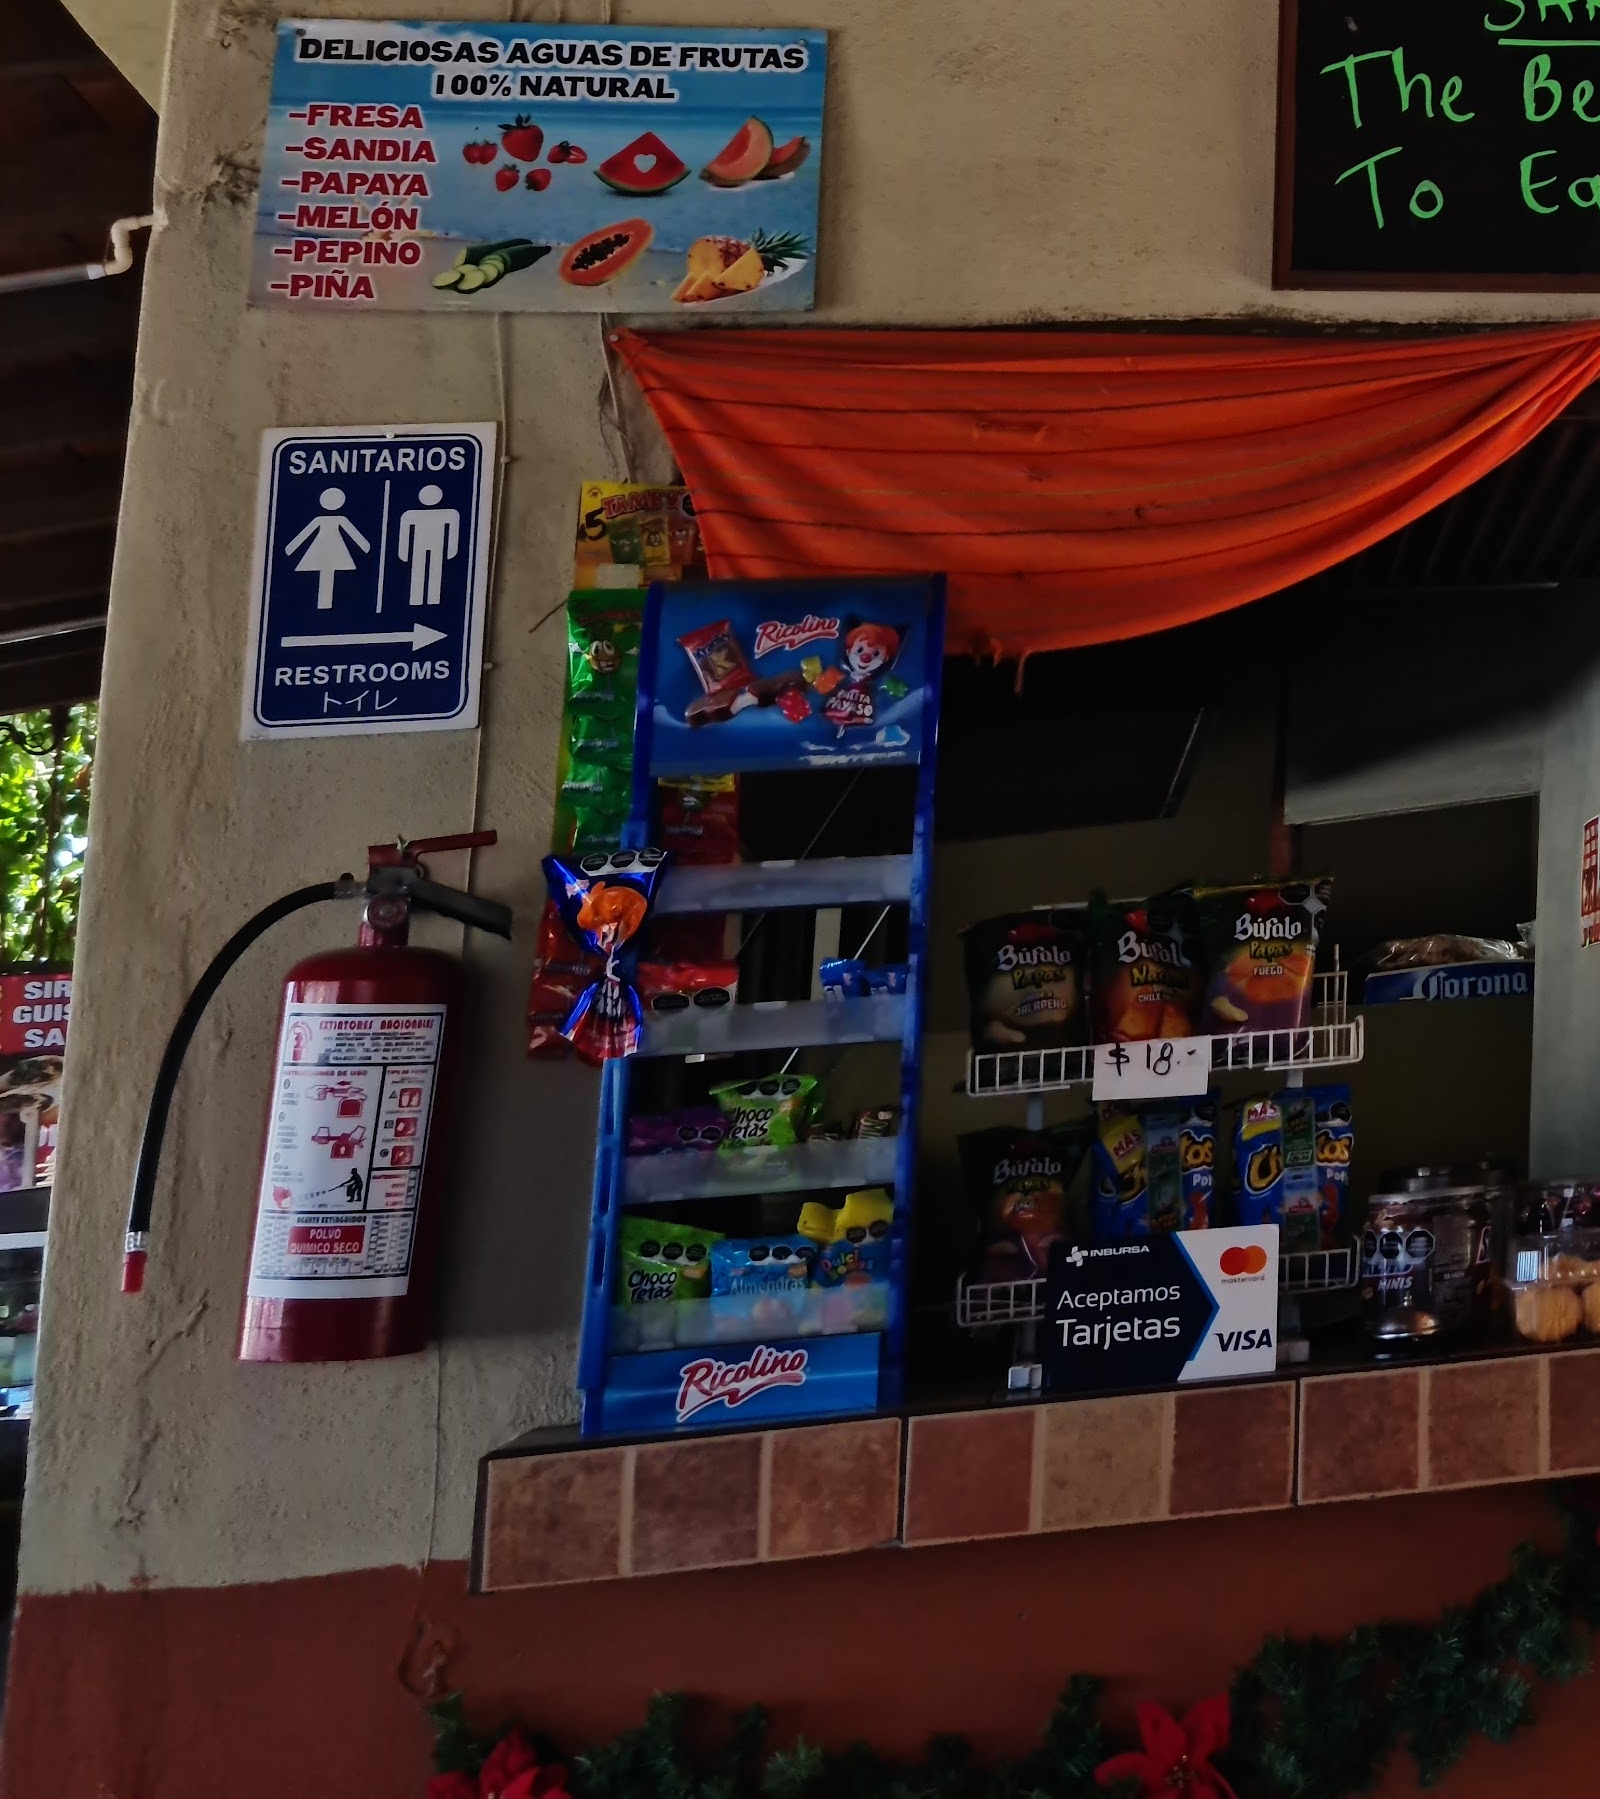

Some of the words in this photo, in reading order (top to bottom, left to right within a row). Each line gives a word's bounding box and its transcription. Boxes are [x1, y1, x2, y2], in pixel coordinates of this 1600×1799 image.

[298, 37, 500, 66] DELICIOSAS
[505, 40, 624, 68] AGUAS
[628, 44, 675, 68] DE
[678, 46, 806, 70] FRUTAS
[434, 73, 512, 99] 100%
[518, 75, 677, 100] NATURAL
[1319, 46, 1476, 129] The
[1335, 146, 1444, 230] To
[288, 447, 466, 475] SANITARIOS
[755, 614, 841, 659] Ricolino
[274, 660, 450, 687] RESTROOMS
[322, 689, 398, 713] トイレ
[825, 694, 874, 718] PAYASO
[1233, 912, 1302, 941] Búfalo
[996, 944, 1072, 971] Búfalo
[1250, 940, 1293, 964] Papas
[1253, 965, 1284, 976] FUEGO
[1400, 969, 1531, 1002] Corona
[309, 1228, 342, 1240] POLVO
[290, 1241, 331, 1254] QUIMICO
[332, 1241, 360, 1253] SECO
[1090, 1244, 1151, 1258] INBURSA
[627, 1269, 677, 1288] Choco
[730, 1276, 807, 1296] Almendras
[1221, 1275, 1266, 1285] mastercard
[1056, 1285, 1182, 1311] Aceptamos
[1055, 1315, 1182, 1351] Tarjetas
[1214, 1328, 1273, 1353] VISA
[676, 1344, 809, 1423] Ricolino
